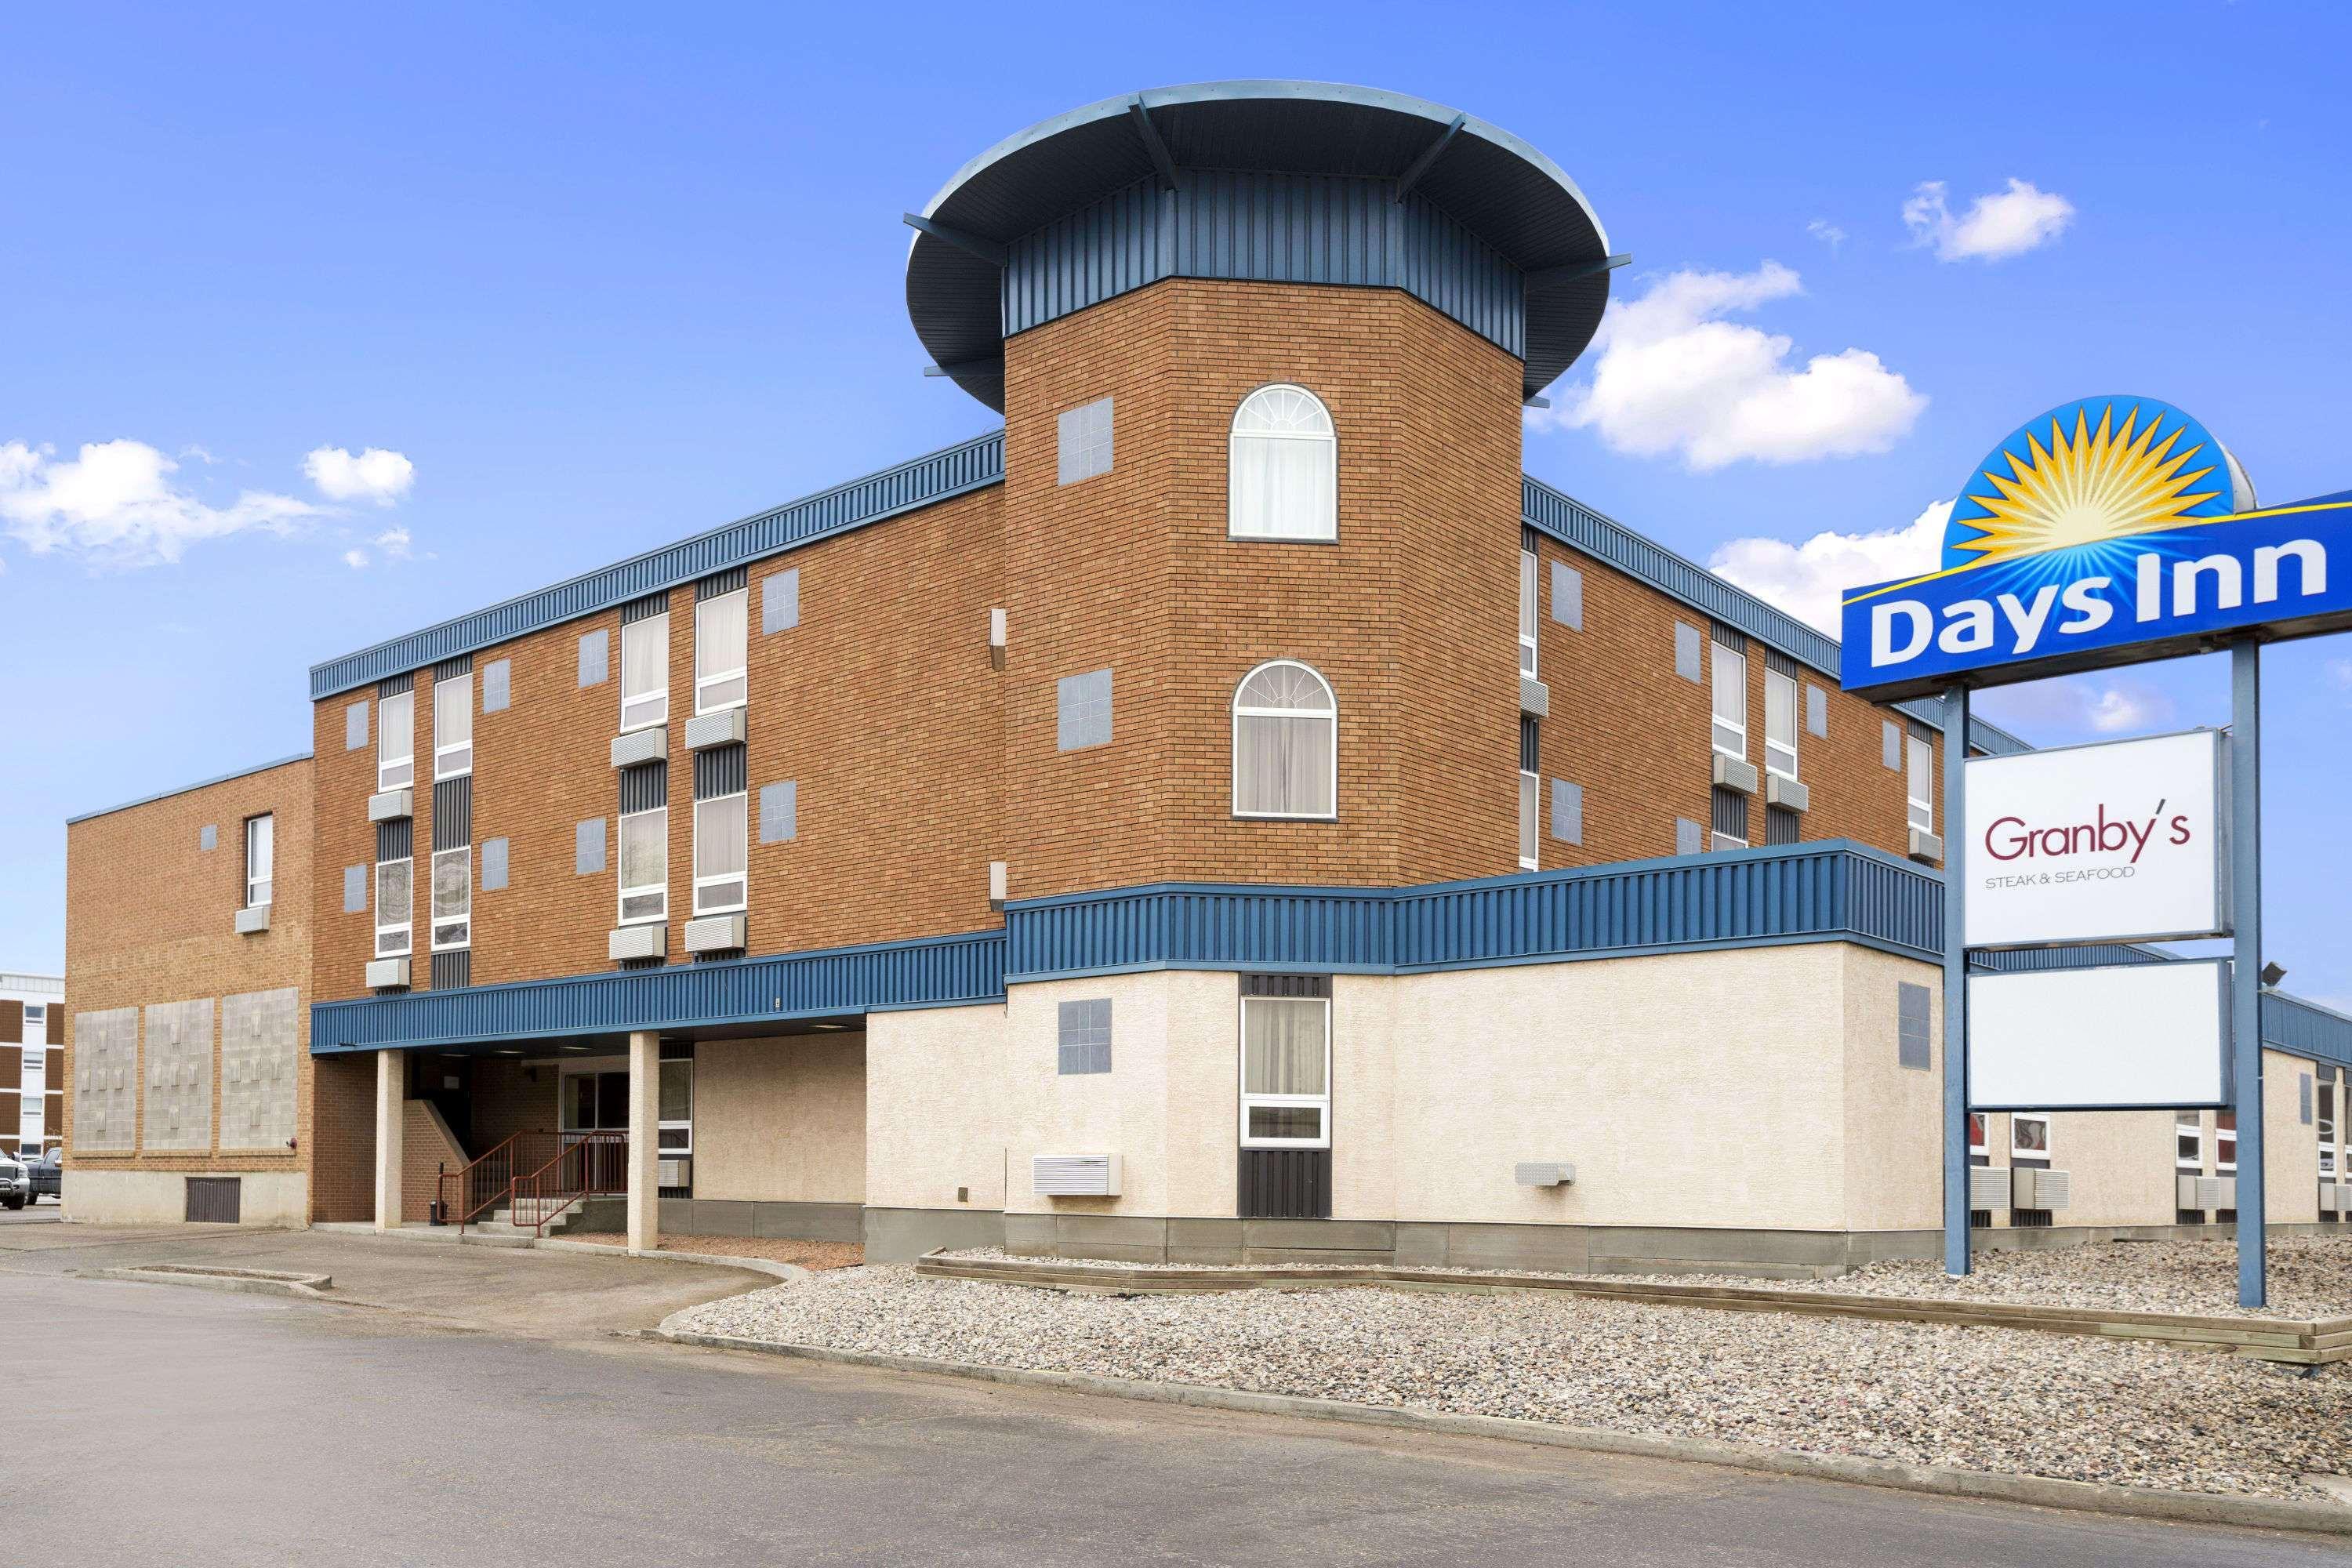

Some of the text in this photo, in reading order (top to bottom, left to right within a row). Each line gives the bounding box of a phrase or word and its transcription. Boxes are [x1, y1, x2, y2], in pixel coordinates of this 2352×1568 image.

[1871, 539, 2326, 667] Days Inn
[1984, 799, 2190, 863] Granby's
[1986, 866, 2135, 889] STEAK & SEAFOOD
